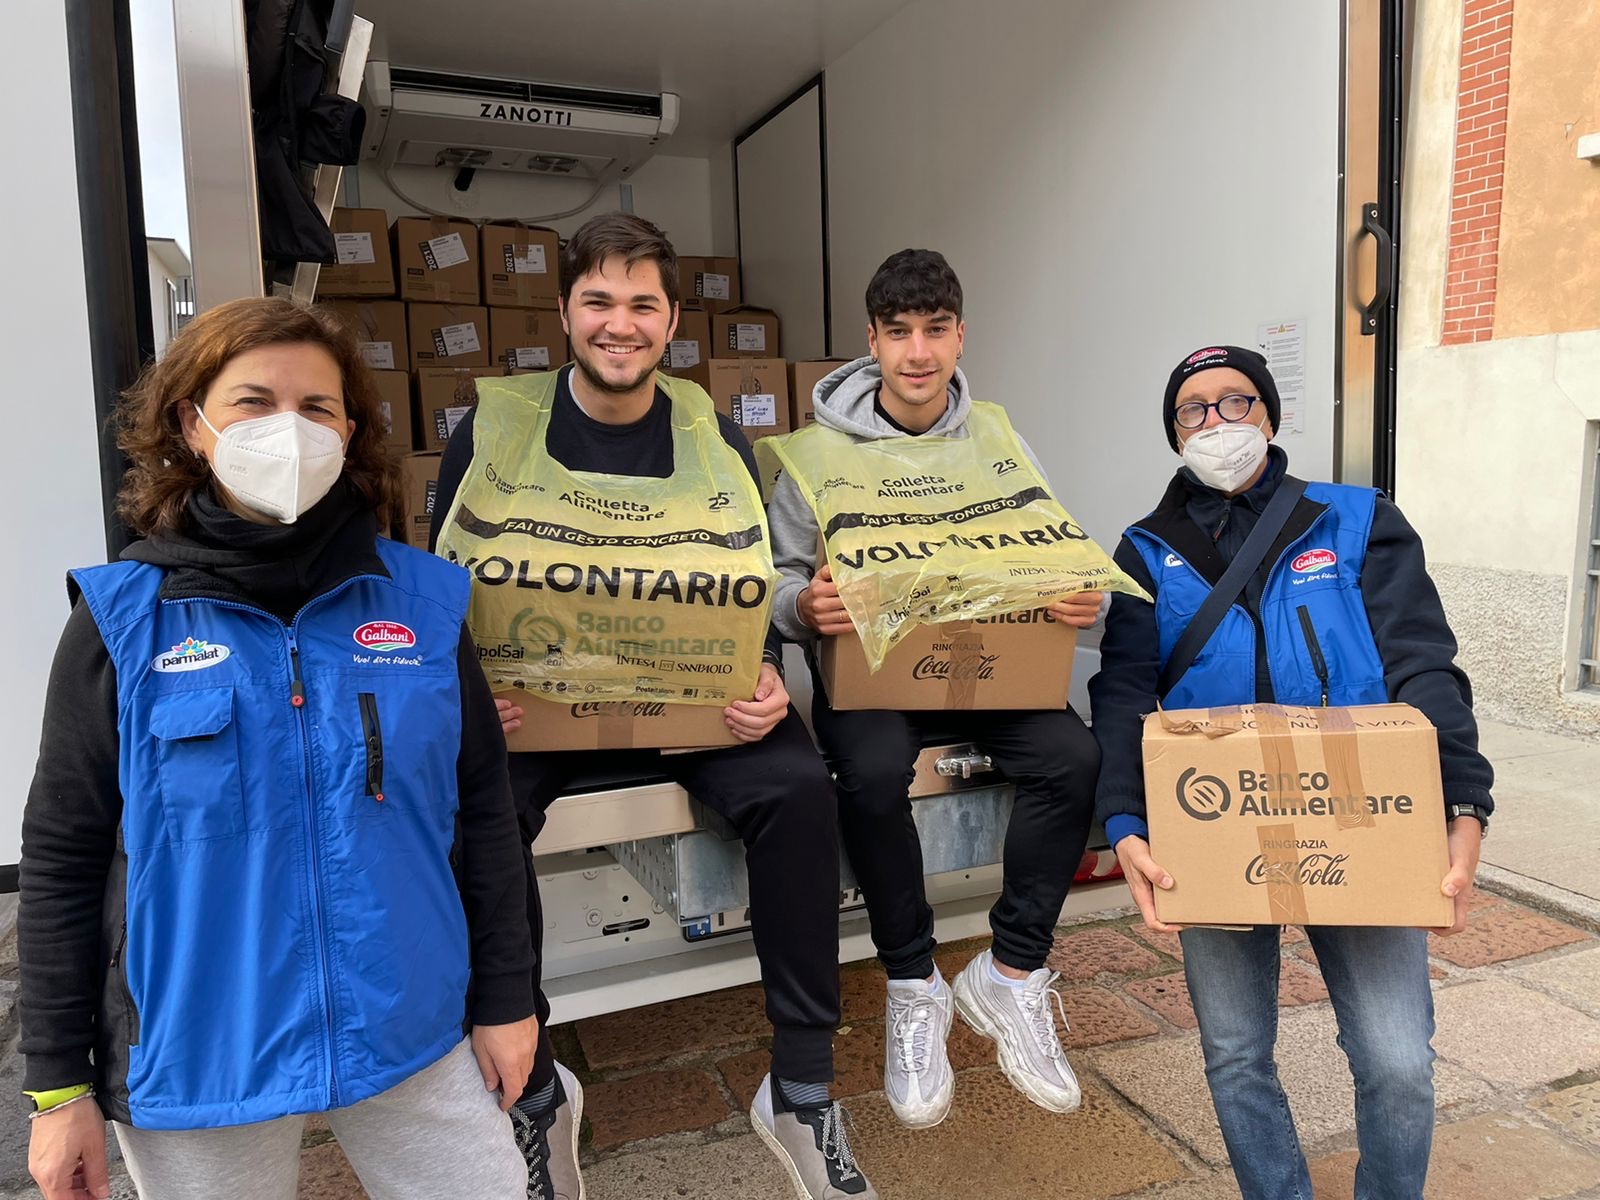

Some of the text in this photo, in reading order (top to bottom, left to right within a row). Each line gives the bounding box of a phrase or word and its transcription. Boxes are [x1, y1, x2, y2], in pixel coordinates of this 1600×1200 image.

[480, 103, 572, 126] ZANOTTI
[992, 458, 1018, 475] 25
[877, 482, 965, 498] Alimentare
[882, 475, 946, 489] Colletta
[558, 492, 666, 522] Alimentare
[573, 490, 650, 512] Colletta
[708, 491, 730, 510] 25
[861, 515, 880, 526] FAI
[882, 515, 902, 525] UN
[946, 499, 1017, 523] CONCRETO
[504, 521, 711, 547] FAI UN GESTO CONCRETO
[1295, 553, 1333, 569] Galbani
[1009, 567, 1046, 577] INTESA
[576, 611, 665, 634] Banco
[361, 628, 409, 642] Galbani
[475, 643, 525, 660] ipolSai
[573, 636, 736, 656] Alimentare
[162, 647, 219, 669] parmalat
[353, 654, 371, 664] Vuol
[373, 655, 391, 664] dire
[616, 654, 733, 675] INTESA SANPAOLO
[912, 654, 1000, 681] CocaCola
[1366, 718, 1417, 728] VITA
[1238, 769, 1330, 793] Banco
[1239, 794, 1413, 817] Alimentare
[1263, 839, 1328, 850] RINGRAZIA
[1245, 853, 1350, 886] CoCola
